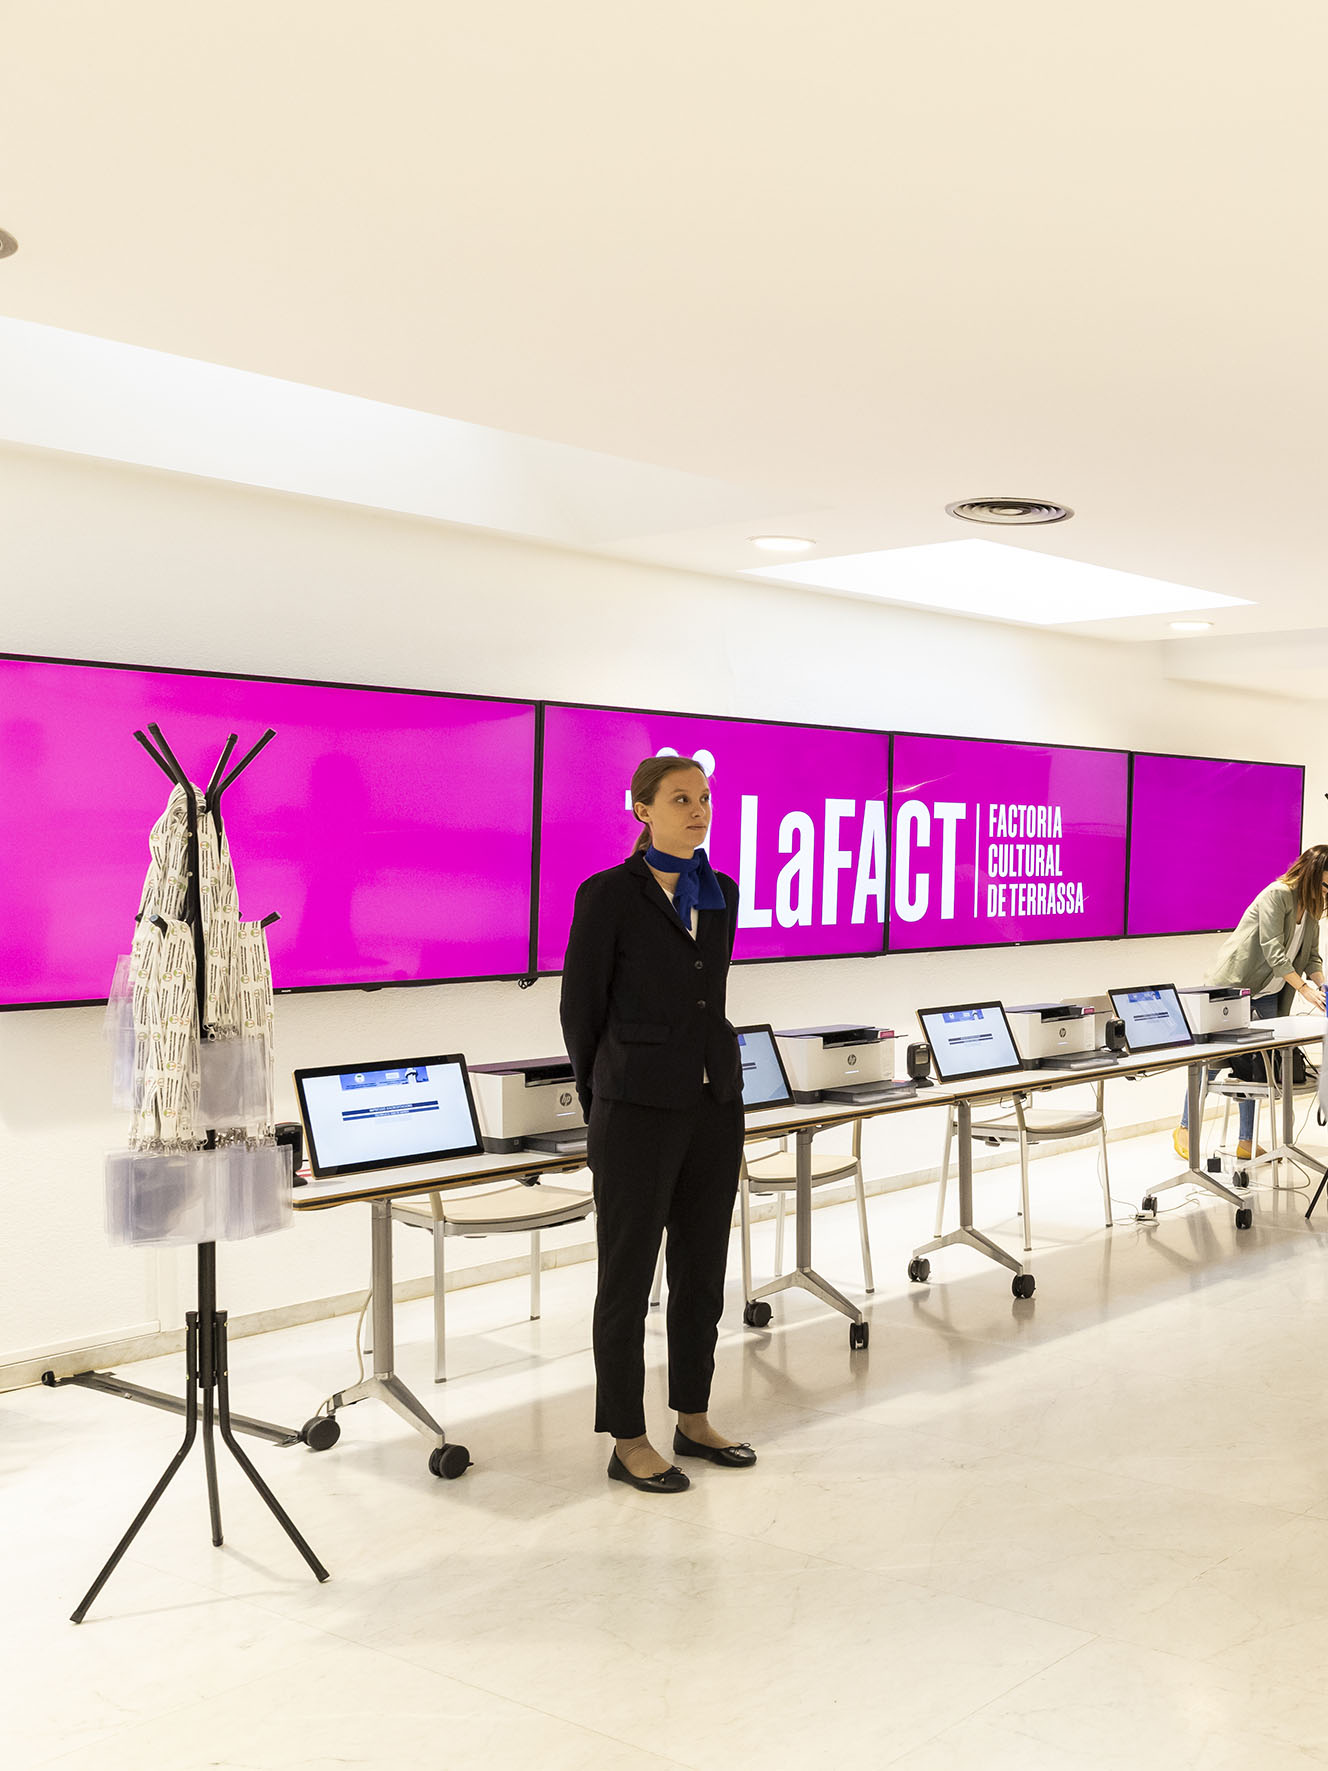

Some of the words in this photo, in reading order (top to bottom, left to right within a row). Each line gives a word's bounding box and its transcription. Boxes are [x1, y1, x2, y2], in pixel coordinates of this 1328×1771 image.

[988, 803, 1063, 840] FACTORIA
[737, 794, 967, 929] LaFACT
[987, 842, 1063, 879] CULTURAL
[987, 883, 1007, 918] DE
[1008, 882, 1084, 916] TERRASSA
[559, 1092, 573, 1107] hp
